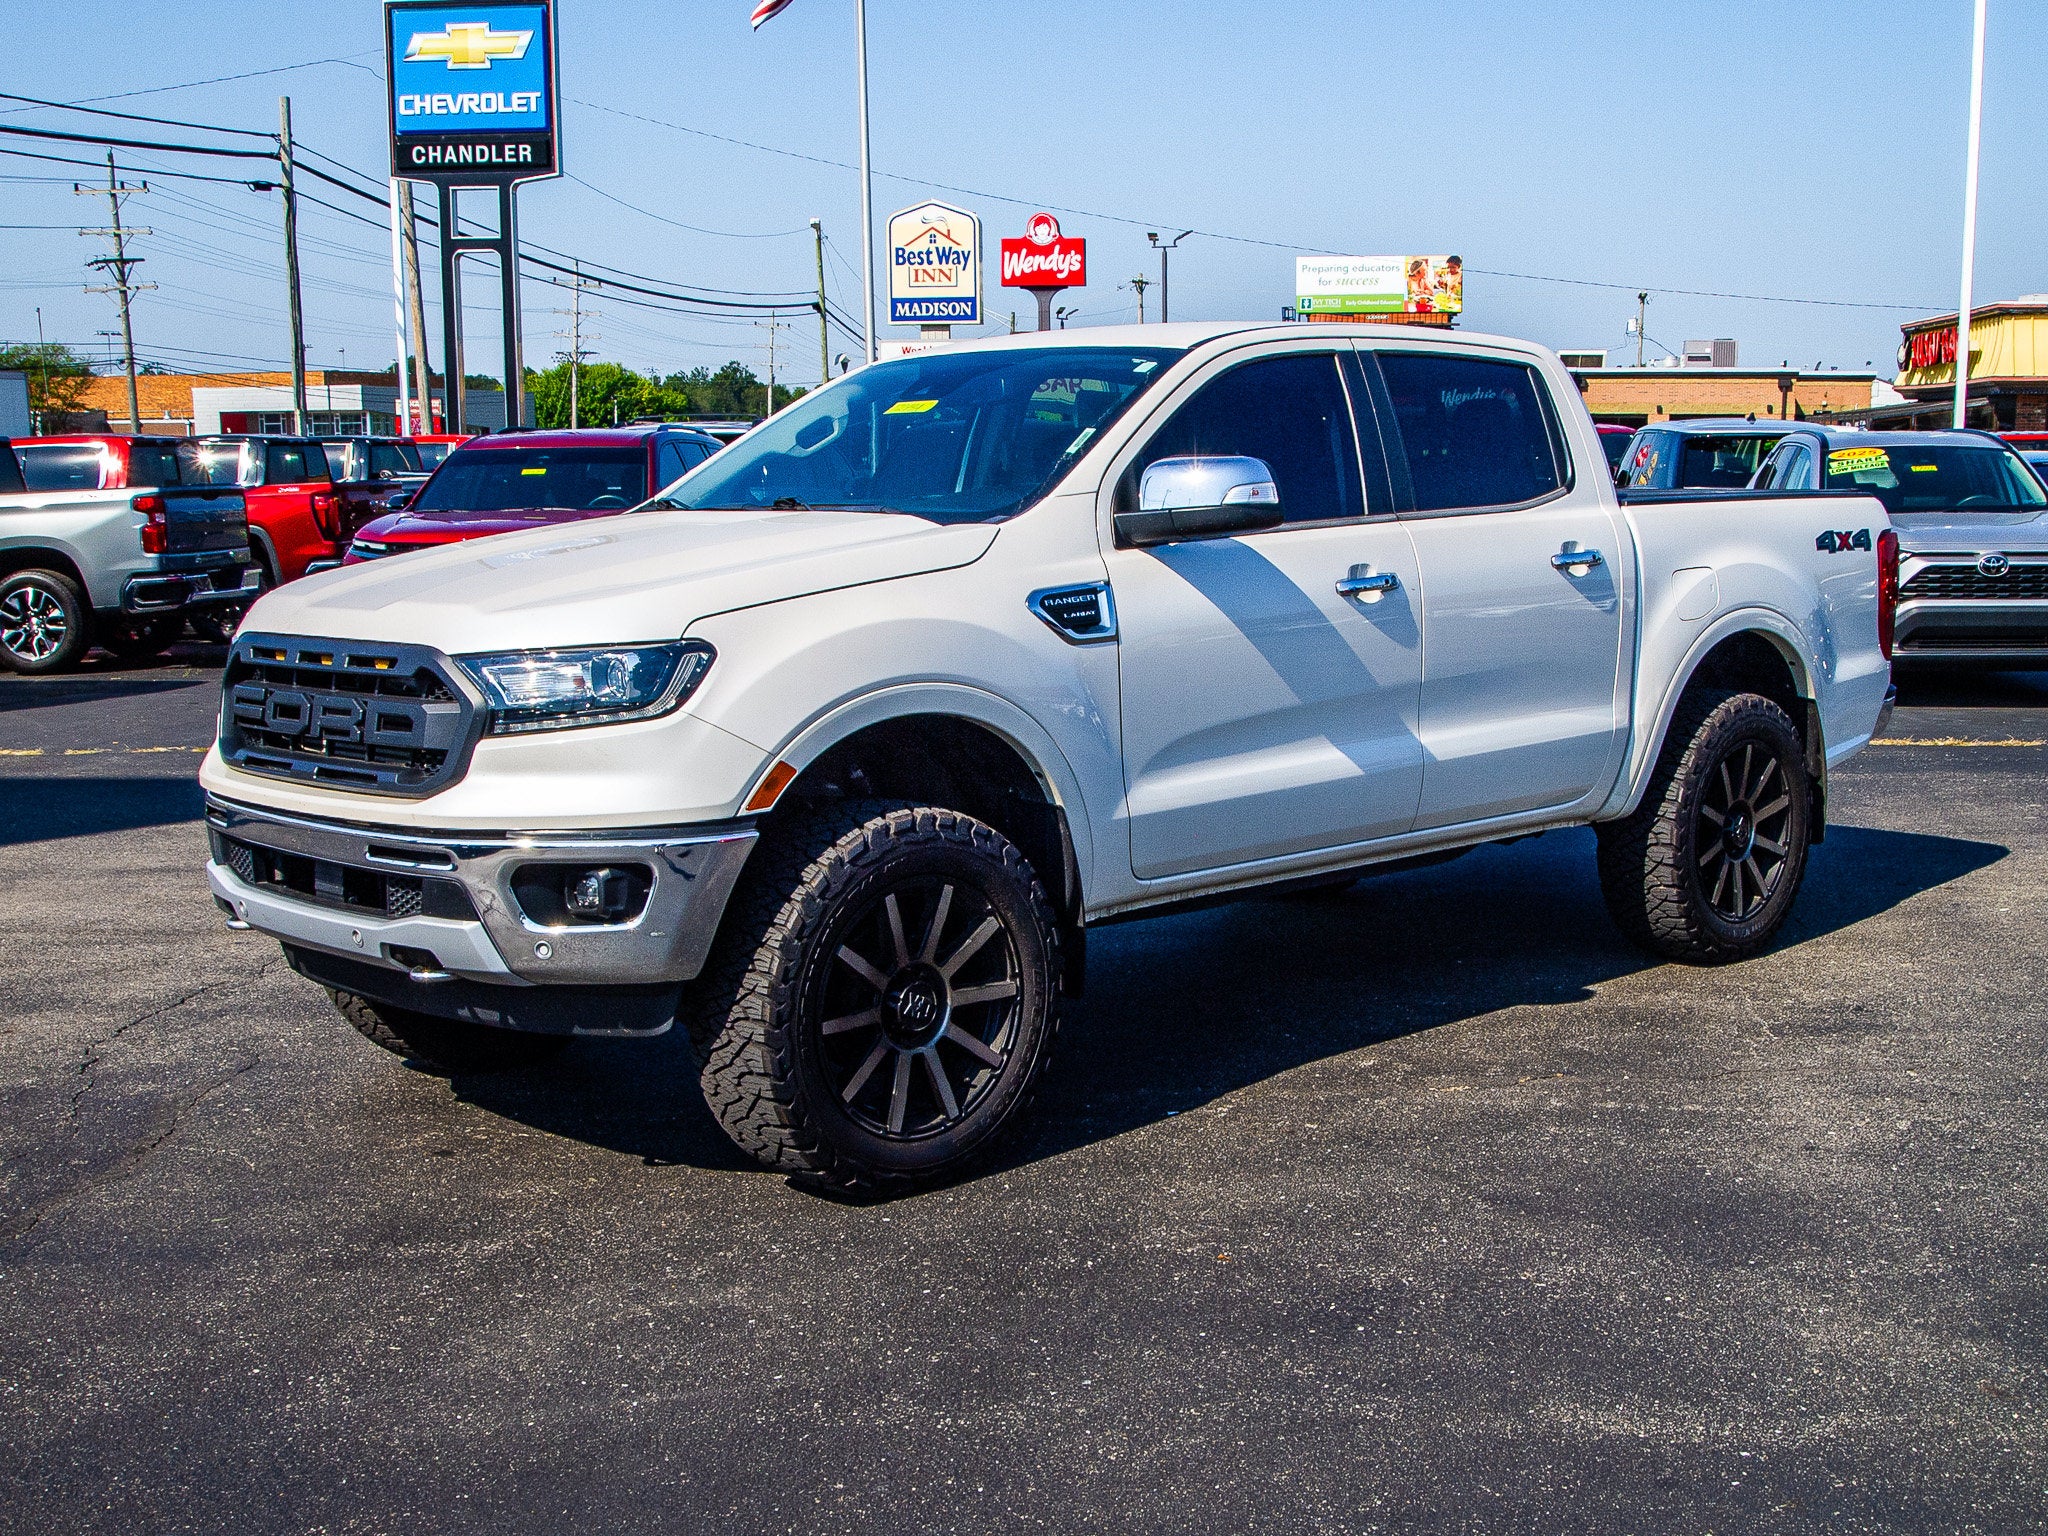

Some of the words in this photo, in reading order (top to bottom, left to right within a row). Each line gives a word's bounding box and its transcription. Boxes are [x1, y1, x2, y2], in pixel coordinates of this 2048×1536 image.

[398, 91, 541, 116] CHEVROLET
[412, 144, 533, 164] CHANDLER
[895, 247, 932, 266] Best
[935, 246, 971, 271] Way
[1003, 244, 1082, 279] Wendy's
[1302, 264, 1349, 274] Preparing
[1352, 263, 1400, 273] educators
[912, 268, 952, 283] INN
[1318, 277, 1332, 286] for
[1335, 277, 1380, 286] success
[895, 301, 972, 317] MADISON
[1837, 449, 1878, 458] 2025
[1837, 456, 1882, 467] SHARP
[1850, 462, 1885, 471] MILEAGE
[1044, 594, 1096, 606] RANGER
[1063, 610, 1096, 619] LARIAT
[233, 684, 428, 749] FORD
